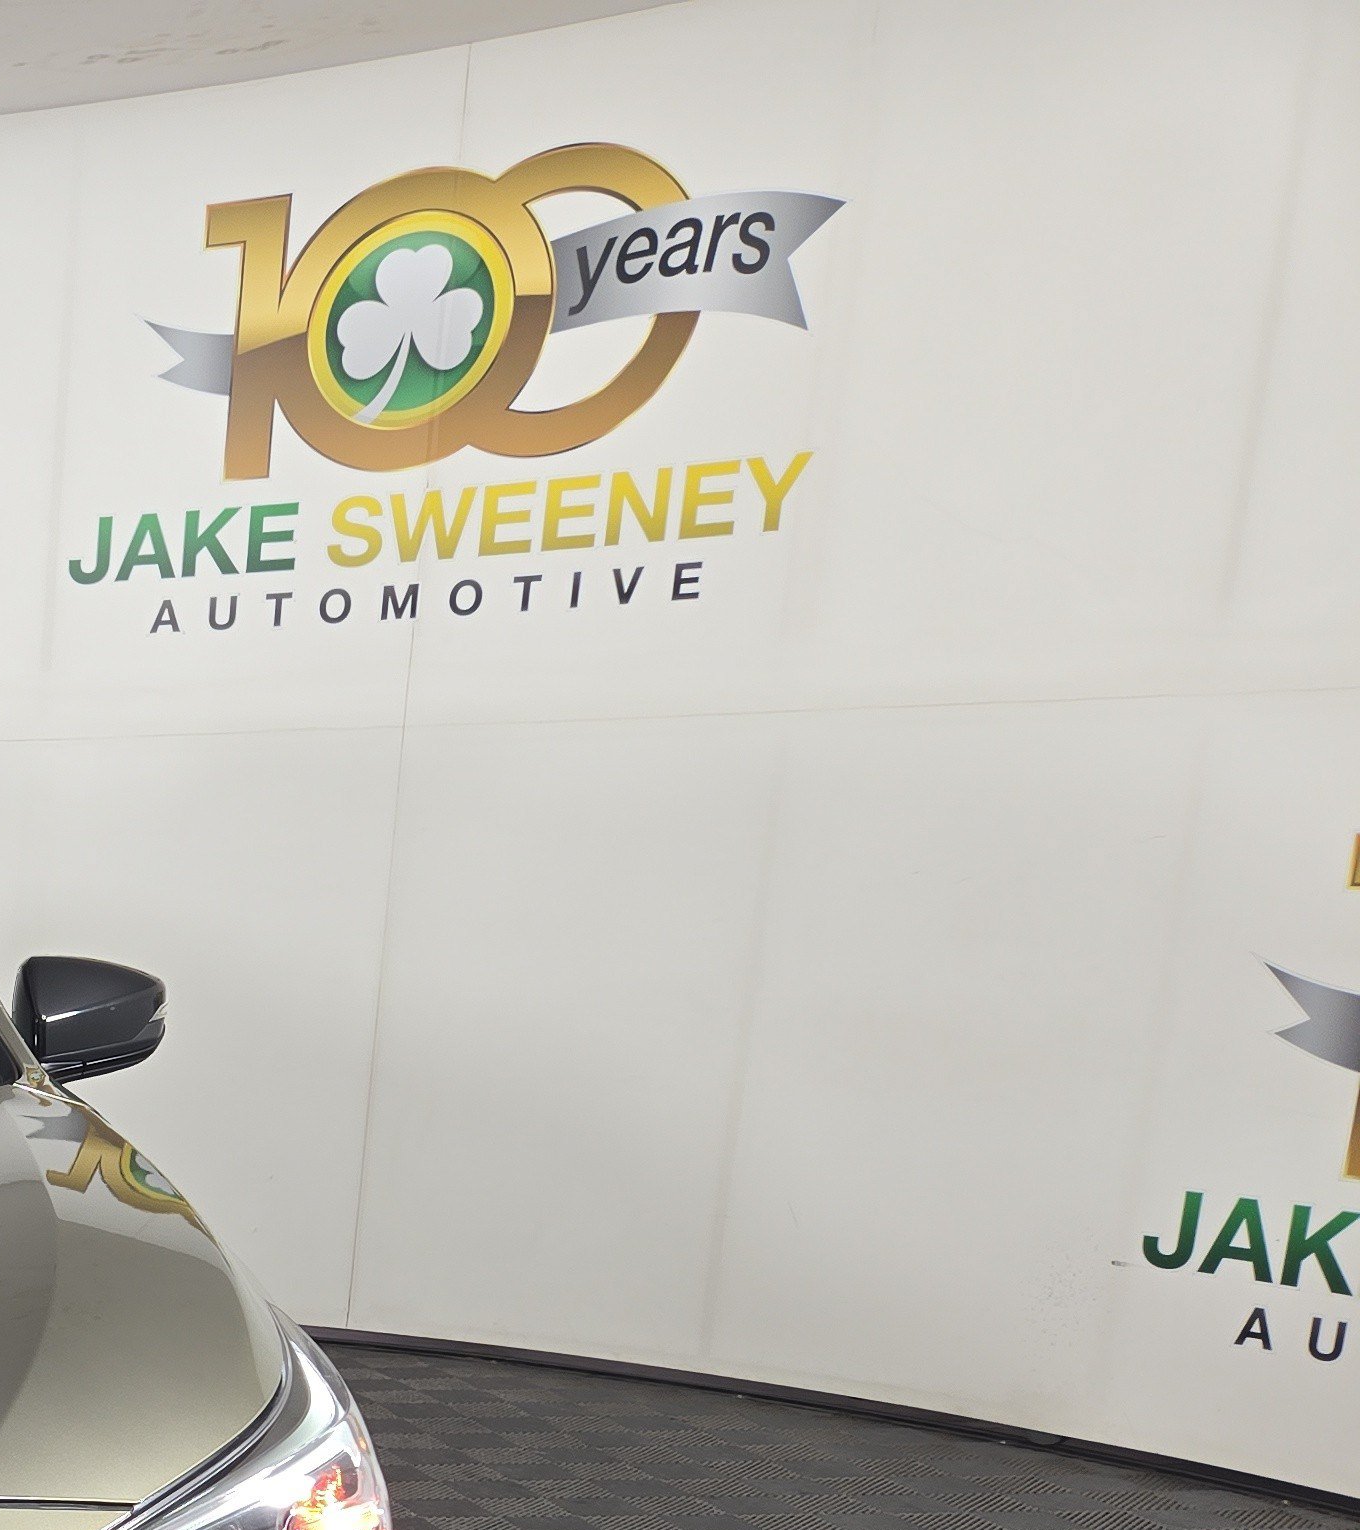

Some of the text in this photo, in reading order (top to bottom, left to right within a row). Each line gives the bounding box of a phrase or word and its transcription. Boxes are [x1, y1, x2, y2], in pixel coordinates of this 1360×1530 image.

[204, 141, 700, 481] 100
[568, 210, 776, 317] years
[68, 451, 814, 586] JAKE SWEENEY
[149, 560, 704, 635] AUTOMOTIVE
[1142, 1190, 1360, 1295] JAK
